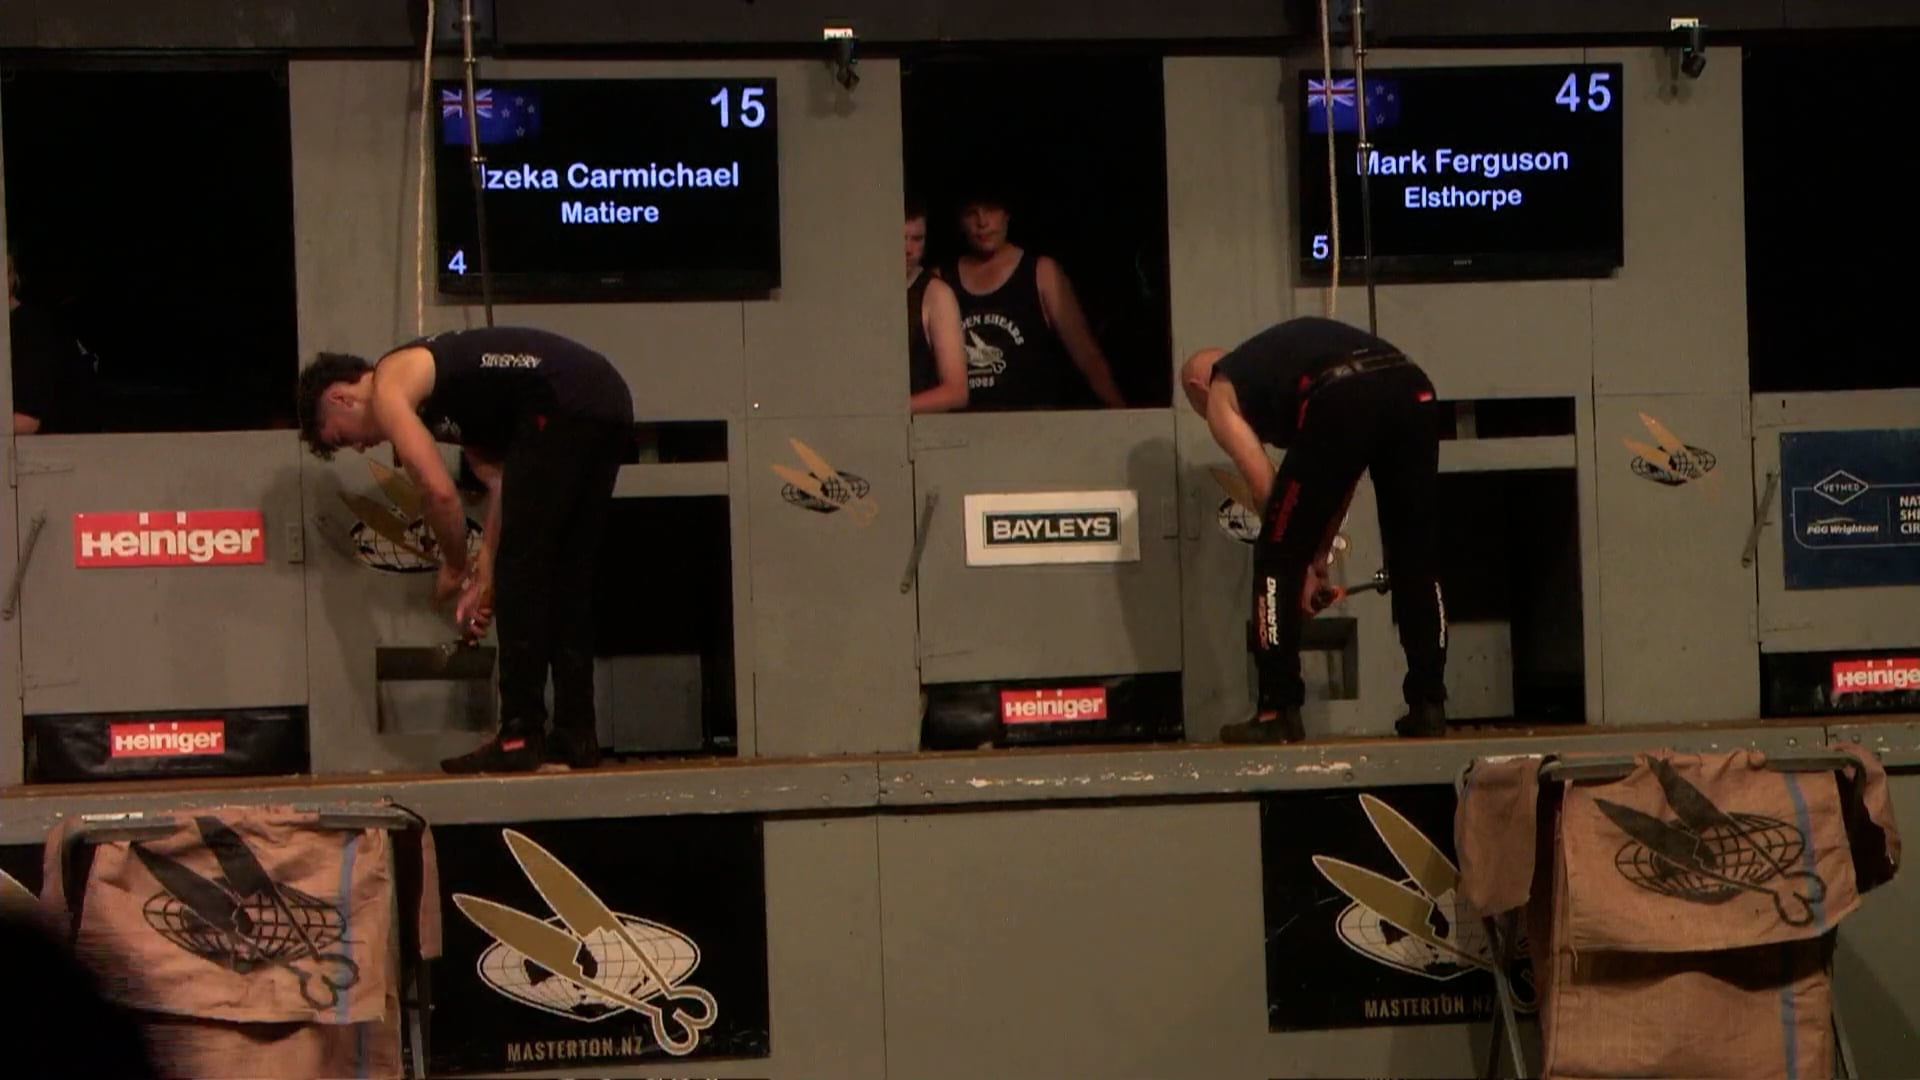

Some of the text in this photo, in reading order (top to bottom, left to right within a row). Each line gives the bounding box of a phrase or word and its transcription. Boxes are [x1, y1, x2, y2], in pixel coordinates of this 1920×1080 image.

[1555, 72, 1611, 112] 45
[710, 87, 766, 128] 15
[567, 162, 740, 188] Carmichael
[1356, 148, 1569, 178] Mark Ferguson
[1404, 186, 1523, 211] Elsthorpe
[561, 201, 660, 224] Matiere
[1312, 235, 1329, 260] 5
[448, 249, 467, 274] 4
[81, 511, 260, 562] Heiniger
[992, 517, 1111, 540] BAYLEYS
[1806, 523, 1879, 536] PGG Wrightson
[1005, 689, 1103, 719] Heiniger
[115, 722, 222, 753] Heiniger
[507, 1035, 644, 1062] MASTERTON.NZ
